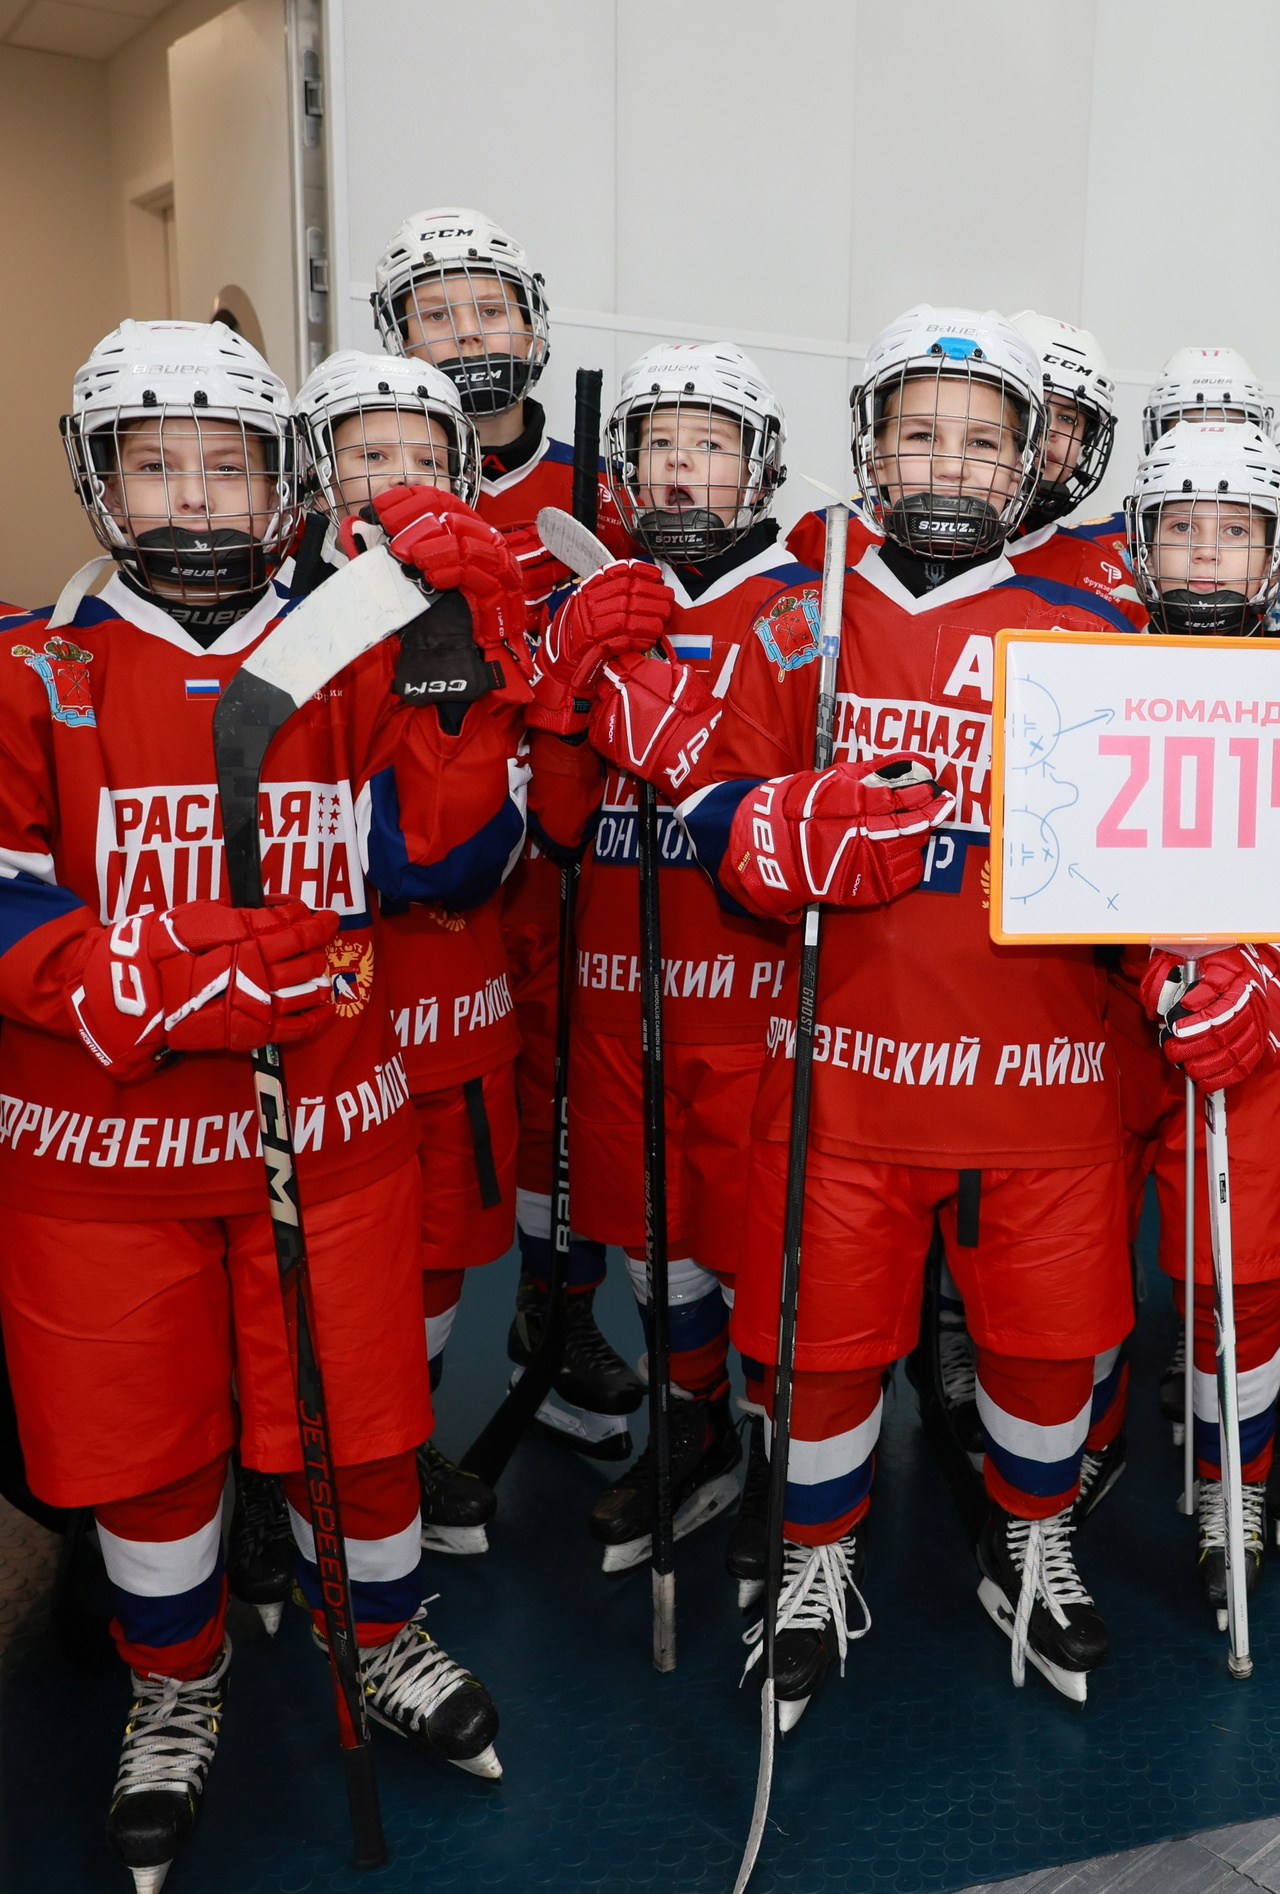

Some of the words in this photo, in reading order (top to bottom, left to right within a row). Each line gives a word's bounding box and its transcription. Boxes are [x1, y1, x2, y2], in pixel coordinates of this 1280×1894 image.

[420, 229, 474, 241] CCM
[132, 364, 211, 375] BAUER
[1043, 354, 1093, 377] CCM
[454, 370, 502, 384] CCM
[918, 520, 969, 533] SOYUZ
[655, 534, 696, 544] SOYUZ
[171, 567, 228, 577] BAUER
[162, 608, 250, 625] AUE
[115, 790, 312, 848] РАСАЯ
[753, 774, 796, 892] BAU
[800, 986, 815, 1037] GHOST
[994, 1036, 1106, 1087] РАЙОН
[0, 1094, 326, 1168] ФРУНЗЕНСКЙ
[300, 1399, 345, 1610] JETSPEED
